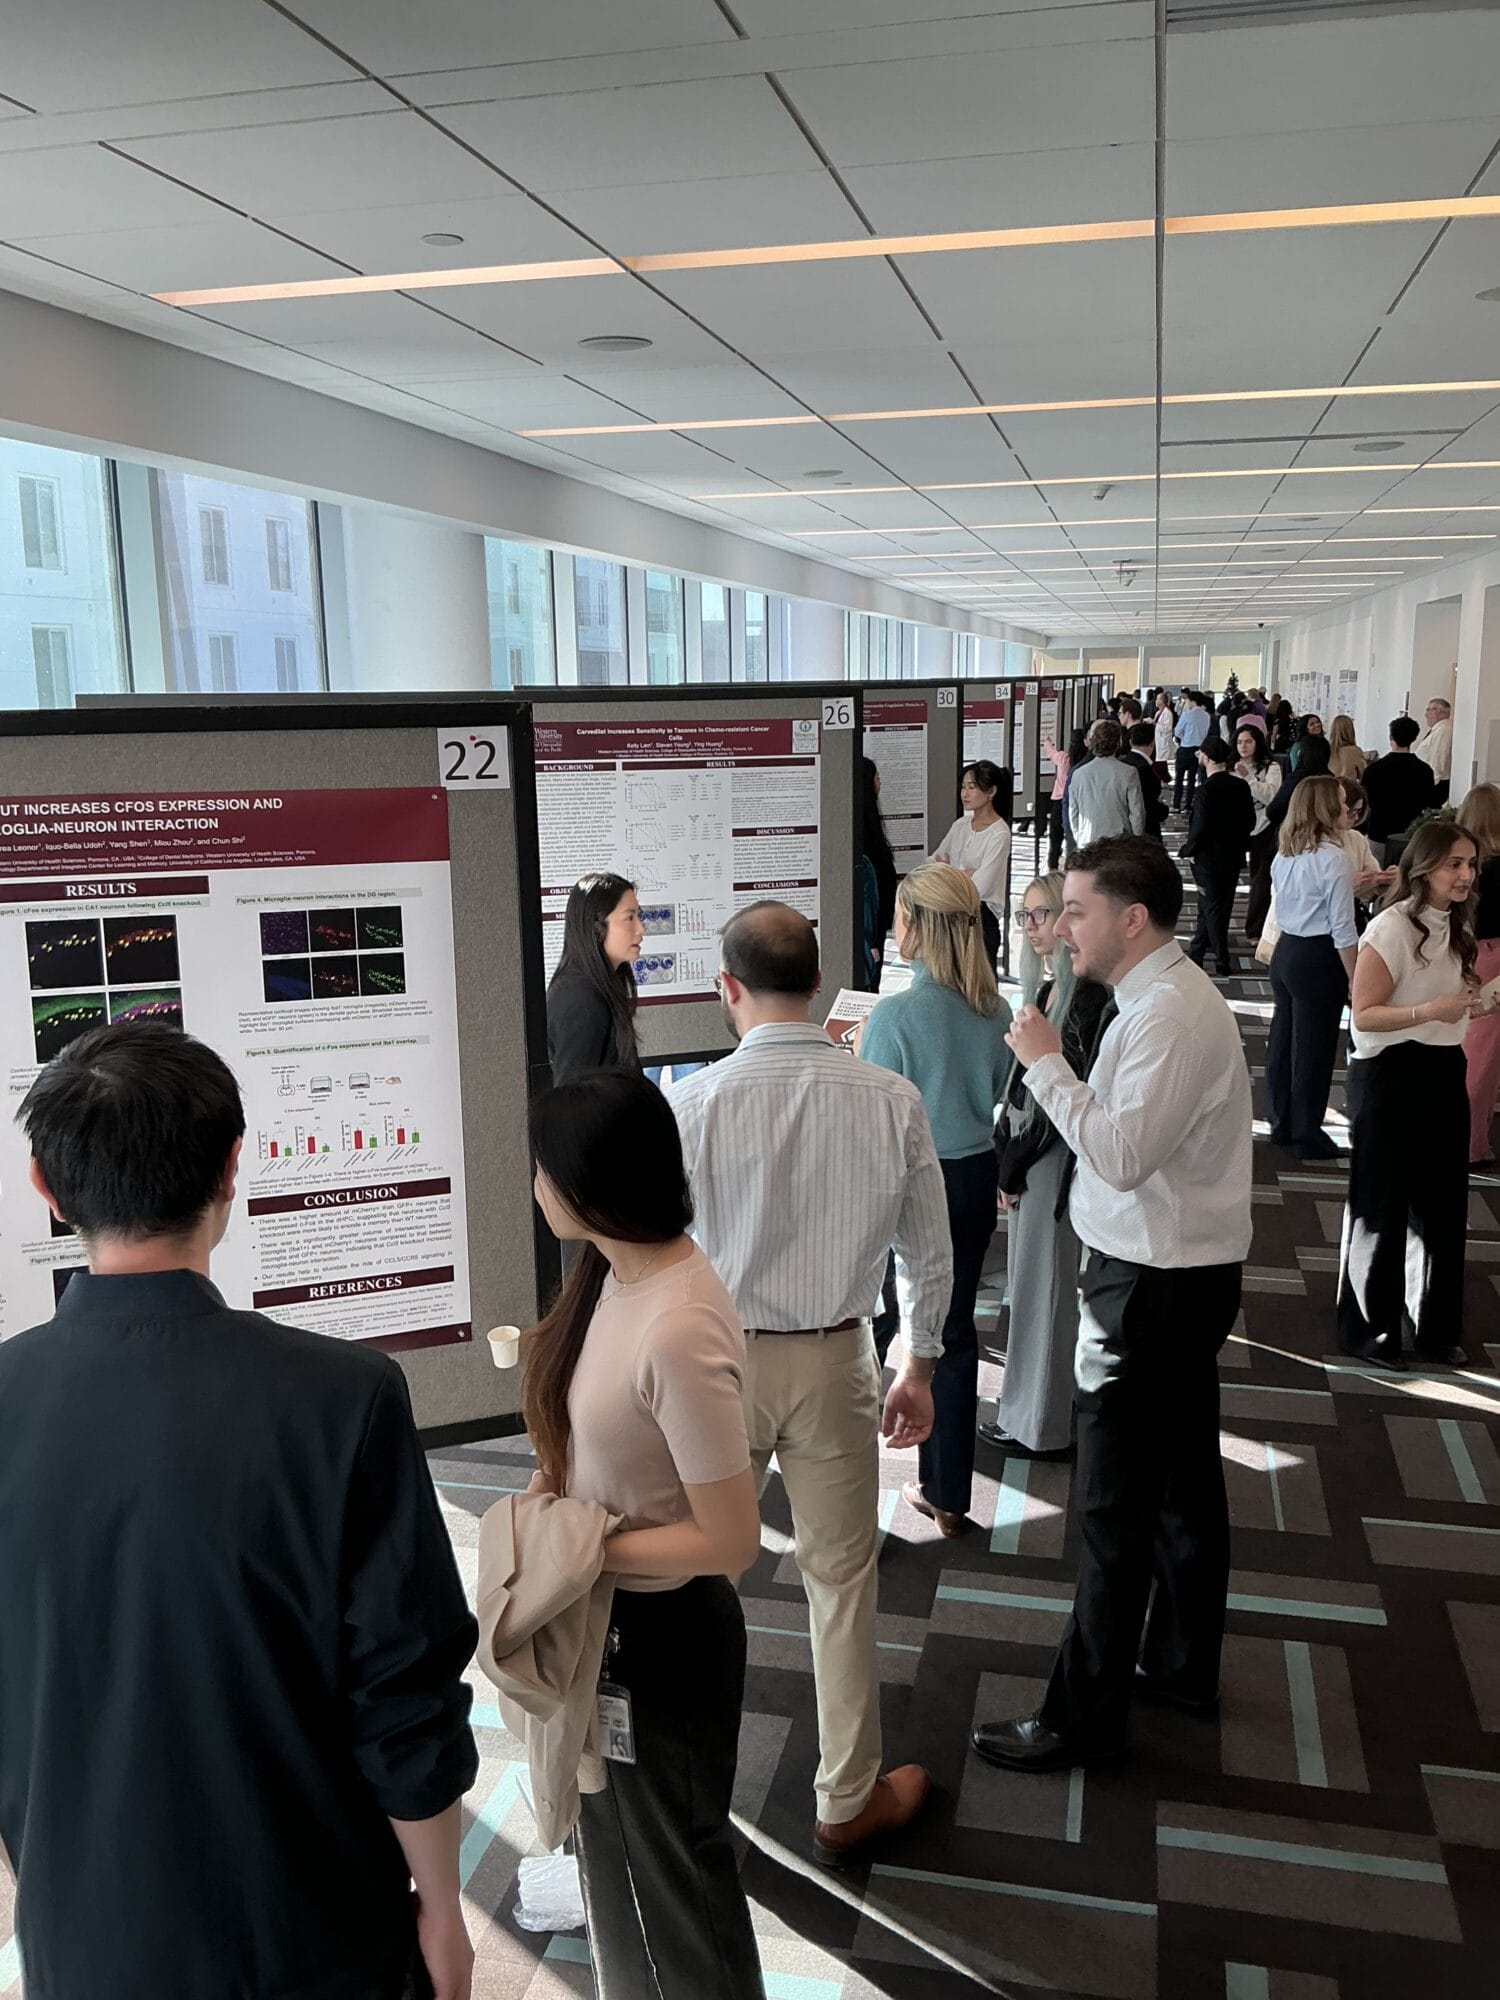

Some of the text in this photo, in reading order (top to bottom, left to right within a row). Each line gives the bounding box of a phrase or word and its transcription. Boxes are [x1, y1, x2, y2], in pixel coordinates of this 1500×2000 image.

[996, 687, 1008, 698] 34
[1026, 684, 1037, 694] 38
[938, 691, 954, 705] 30
[824, 704, 850, 726] 26
[444, 740, 498, 780] 22
[24, 801, 110, 815] INCREASES
[114, 800, 154, 812] CFOS
[158, 797, 249, 811] EXPRESSION
[253, 796, 283, 808] AND
[0, 817, 218, 834] OGLIA-NEURON INTERACTION
[109, 840, 127, 848] Yang
[154, 838, 171, 846] Miou
[211, 836, 230, 844] Chun
[66, 882, 136, 896] RESULTS
[753, 881, 799, 889] CONCLUSIONS
[303, 1185, 398, 1207] CONCLUSION
[309, 1275, 402, 1298] REFERENCES
